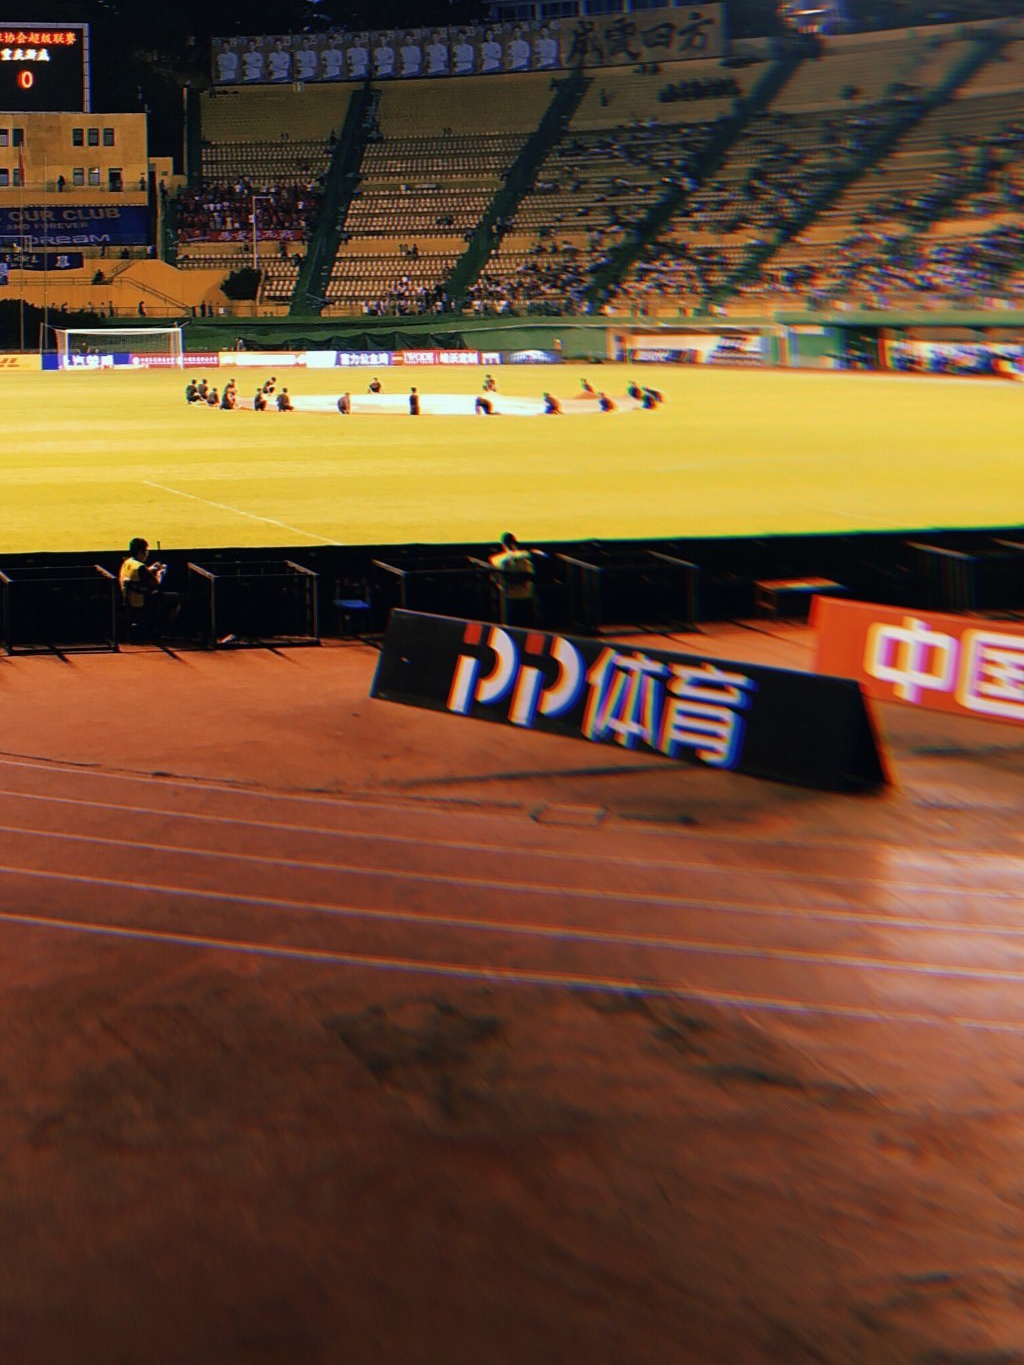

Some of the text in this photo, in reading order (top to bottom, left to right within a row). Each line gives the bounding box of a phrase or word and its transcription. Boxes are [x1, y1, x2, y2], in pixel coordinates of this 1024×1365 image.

[18, 71, 34, 89] 0
[8, 210, 54, 223] OUR
[63, 208, 122, 220] CLUB
[6, 223, 30, 231] AND
[34, 222, 89, 230] FOREVER
[863, 615, 1024, 721] 中国
[447, 623, 759, 770] PP体育
